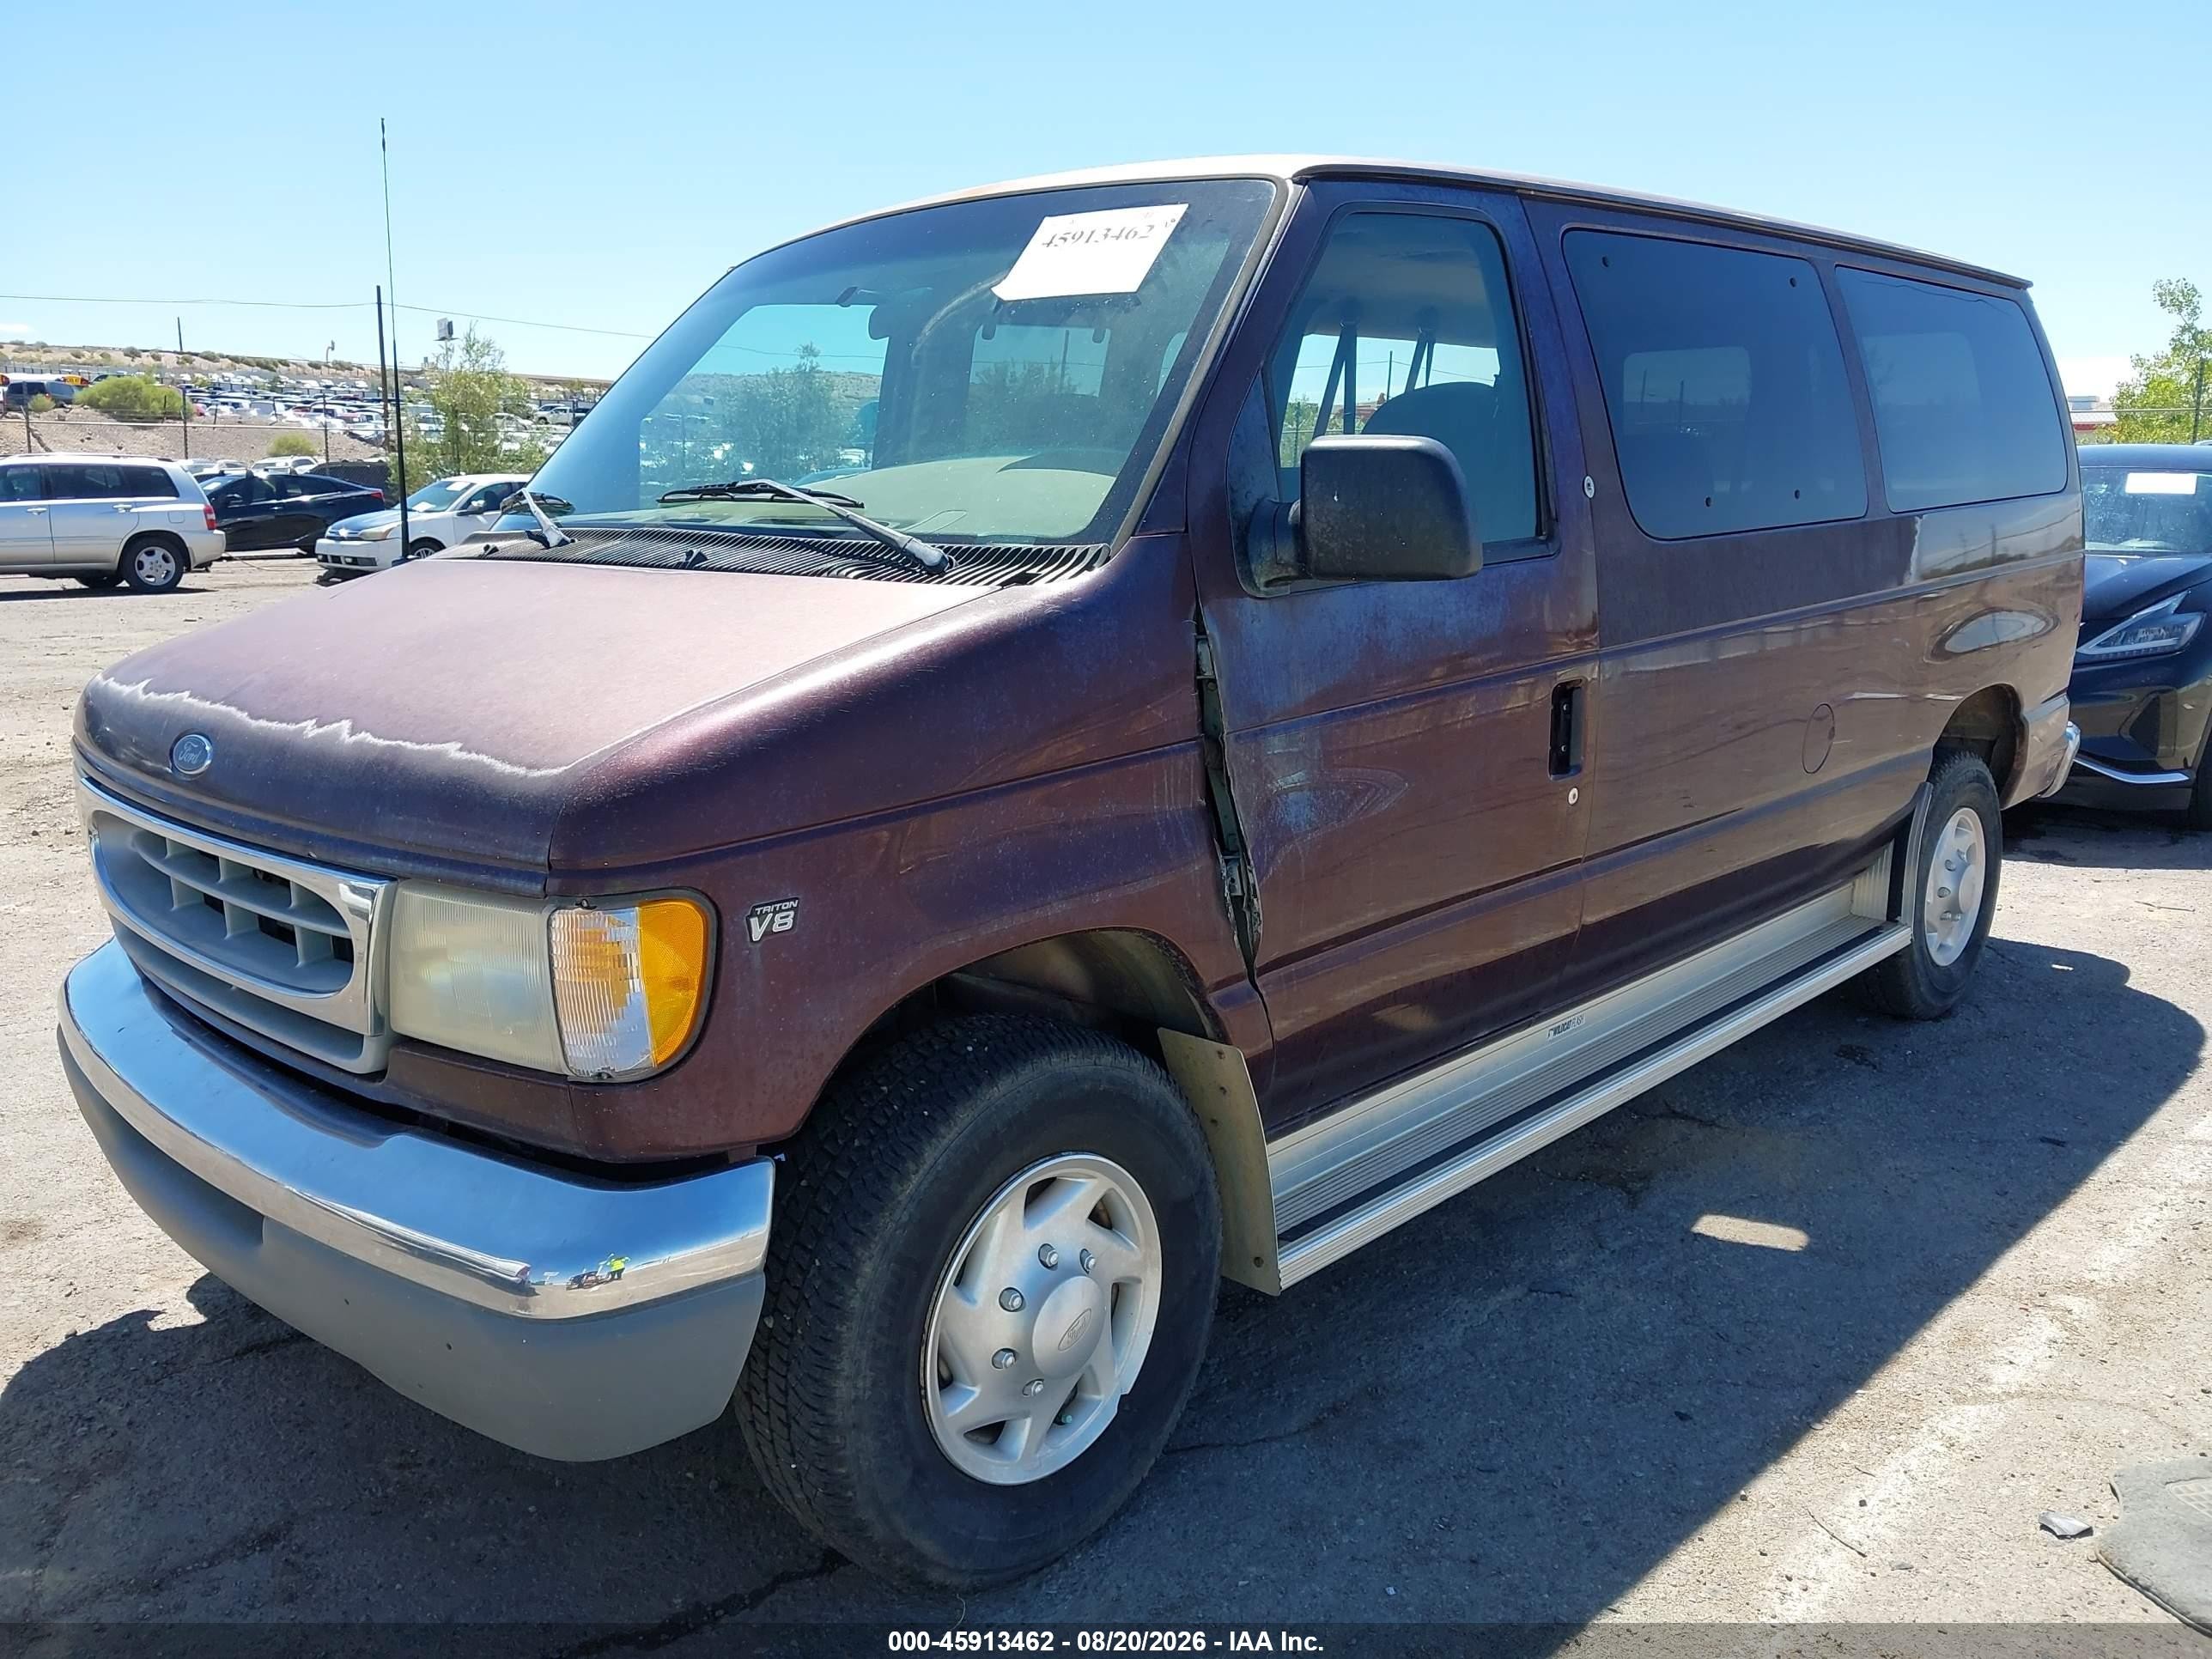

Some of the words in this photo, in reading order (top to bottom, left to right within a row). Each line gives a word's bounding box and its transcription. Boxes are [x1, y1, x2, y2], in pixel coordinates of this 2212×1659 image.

[1041, 224, 1155, 248] 45913462
[755, 899, 799, 915] TRITON
[750, 910, 794, 942] V8
